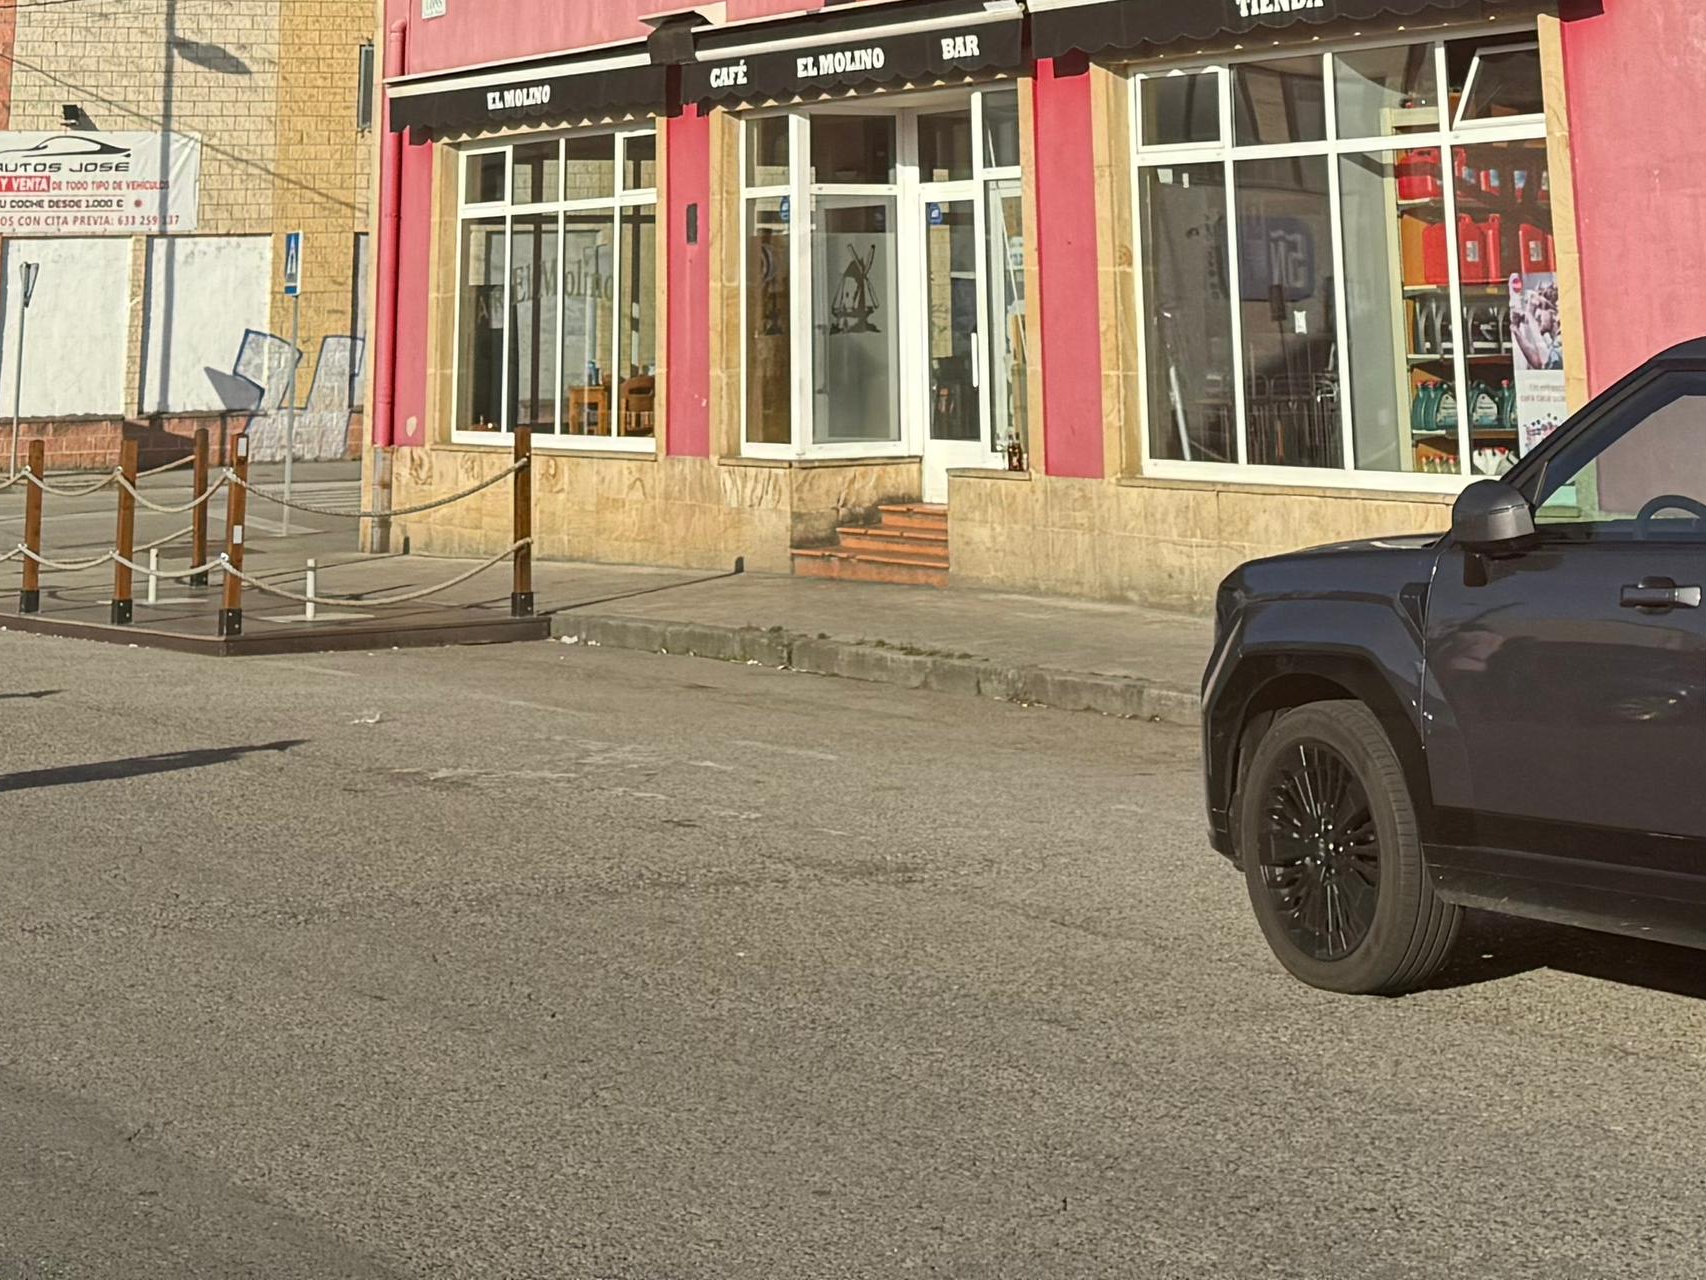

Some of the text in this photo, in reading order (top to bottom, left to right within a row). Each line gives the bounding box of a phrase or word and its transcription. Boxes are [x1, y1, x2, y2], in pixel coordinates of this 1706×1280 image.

[710, 34, 980, 88] CAFÉ EL MOLINO BAR
[486, 84, 551, 110] EL MOLINO
[69, 162, 130, 172] JOSE
[0, 177, 10, 191] Y
[13, 176, 49, 191] VENTA
[52, 181, 62, 190] DE
[66, 181, 88, 190] TODO
[91, 181, 109, 190] TIPO
[112, 181, 123, 190] DE
[10, 200, 44, 208] COCHE
[48, 200, 82, 208] DESDE
[18, 216, 40, 226] CON
[45, 216, 69, 226] CITA
[73, 215, 114, 226] PREVIA:
